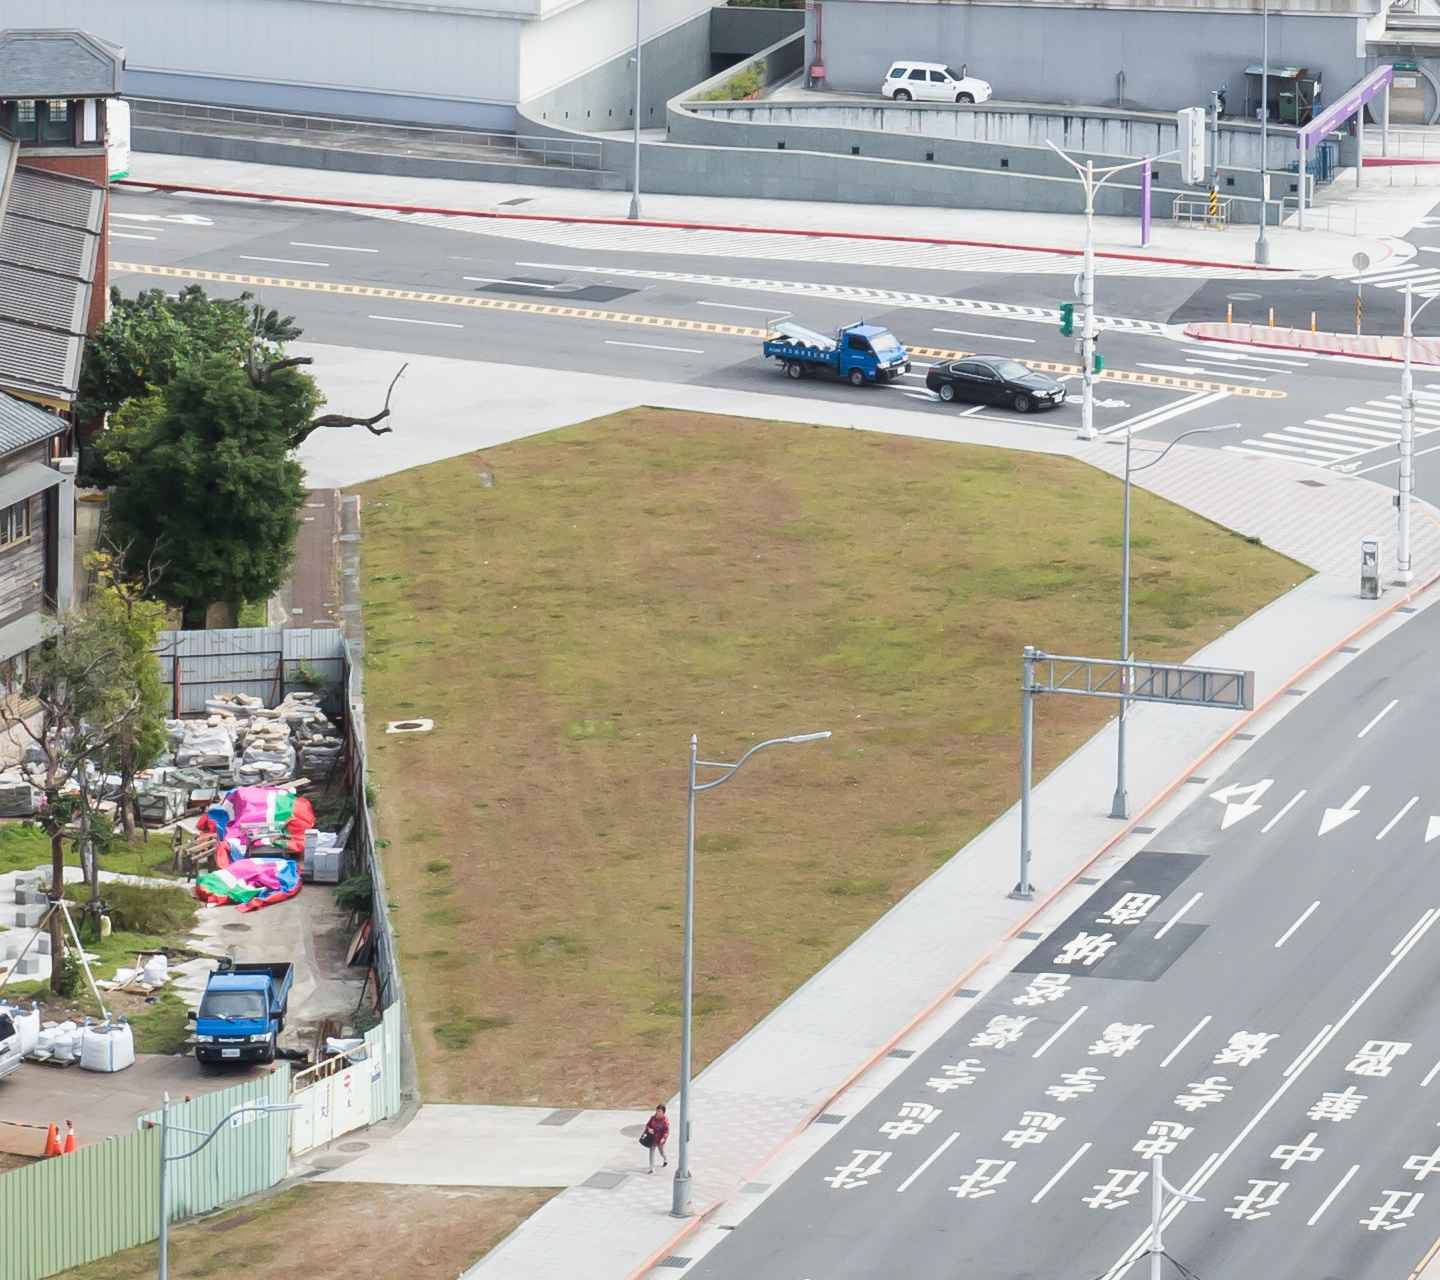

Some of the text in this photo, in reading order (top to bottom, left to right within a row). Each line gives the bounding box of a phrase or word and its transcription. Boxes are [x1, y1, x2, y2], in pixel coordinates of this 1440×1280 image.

[947, 1021, 1155, 1199] 往忠孝橋
[1081, 1030, 1280, 1210] 往忠孝橋
[1223, 1039, 1414, 1221] 往中華路
